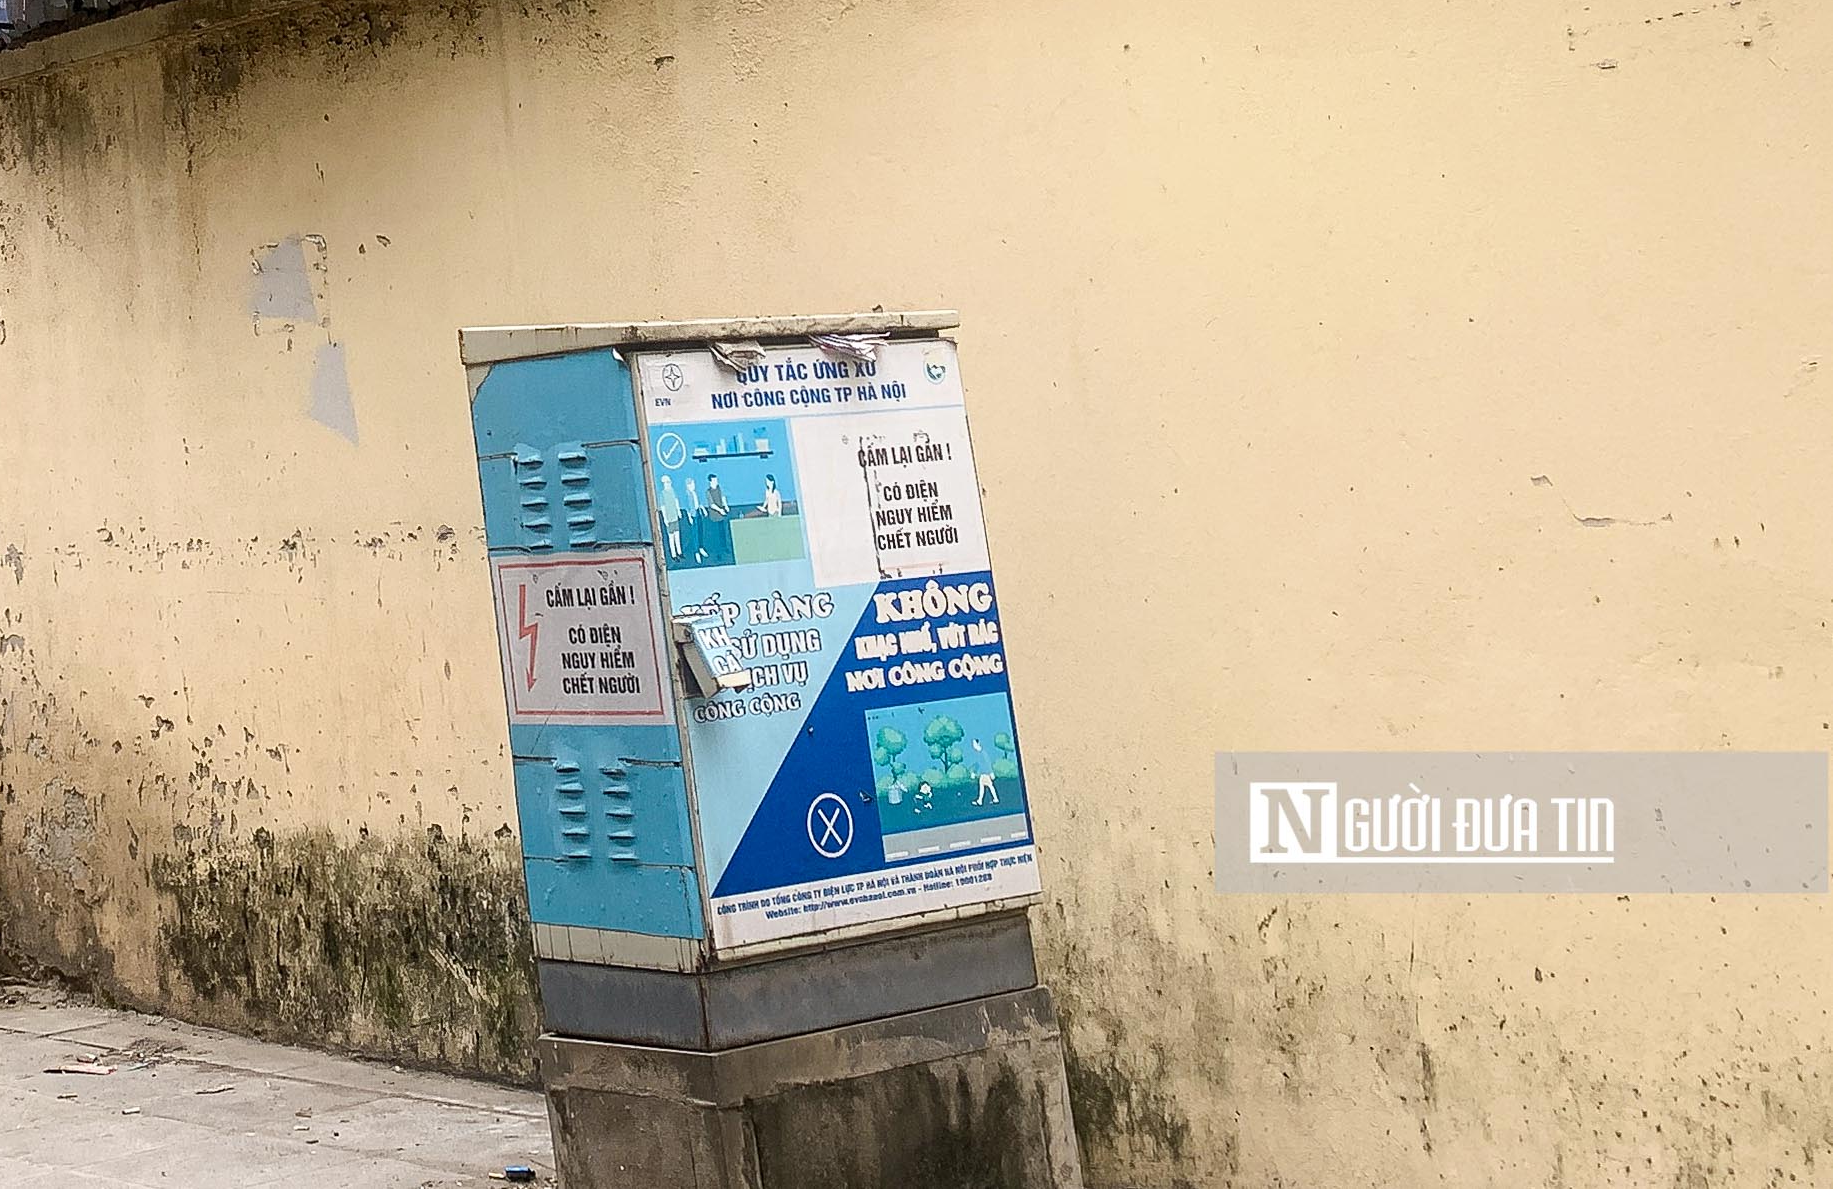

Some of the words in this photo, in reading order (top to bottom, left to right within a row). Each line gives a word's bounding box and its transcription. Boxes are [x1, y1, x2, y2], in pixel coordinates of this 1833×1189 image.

[736, 363, 769, 385] QUY
[774, 357, 808, 381] TẮC
[814, 359, 849, 380] ỨNG
[654, 397, 672, 407] EVN
[711, 392, 739, 410] NƠI
[742, 387, 786, 409] CÔNG
[789, 387, 832, 408] CỘNG
[834, 387, 852, 403] TP
[857, 382, 878, 401] HÀ
[881, 380, 907, 402] NỘI
[891, 446, 913, 468] LẠI
[883, 482, 902, 501] CÓ
[906, 480, 939, 502] ĐIỆN
[876, 508, 913, 527] NGUY
[917, 499, 953, 523] HIỂM
[877, 527, 912, 550] CHẾT
[916, 524, 959, 547] NGƯỜI
[545, 582, 574, 608] CẤM
[577, 588, 597, 610] LẠI
[600, 580, 626, 606] GẦN
[629, 585, 635, 605] !
[746, 591, 835, 625] HÀNG
[873, 579, 993, 624] KHÔNG
[568, 624, 586, 644] CÓ
[589, 623, 622, 648] ĐIỆN
[730, 629, 758, 660] SỬ
[761, 628, 822, 660] DỤNG
[854, 633, 899, 661] KHẠC
[937, 622, 967, 650] VỨT
[968, 618, 999, 646] RÁC
[561, 651, 596, 670] NGUY
[600, 646, 635, 669] HIỂM
[563, 672, 595, 694] CHẾT
[598, 672, 641, 694] NGƯỜI
[781, 661, 808, 687] VỤ
[845, 667, 887, 693] NƠI
[888, 661, 946, 687] CÔNG
[948, 653, 1004, 681] CỘNG
[693, 699, 746, 724] CÔNG
[748, 692, 801, 717] CỘNG
[717, 902, 737, 916] CÔNG
[761, 898, 771, 908] DO
[792, 890, 813, 903] CÔNG
[814, 890, 822, 900] TY
[765, 906, 801, 919] Website:
